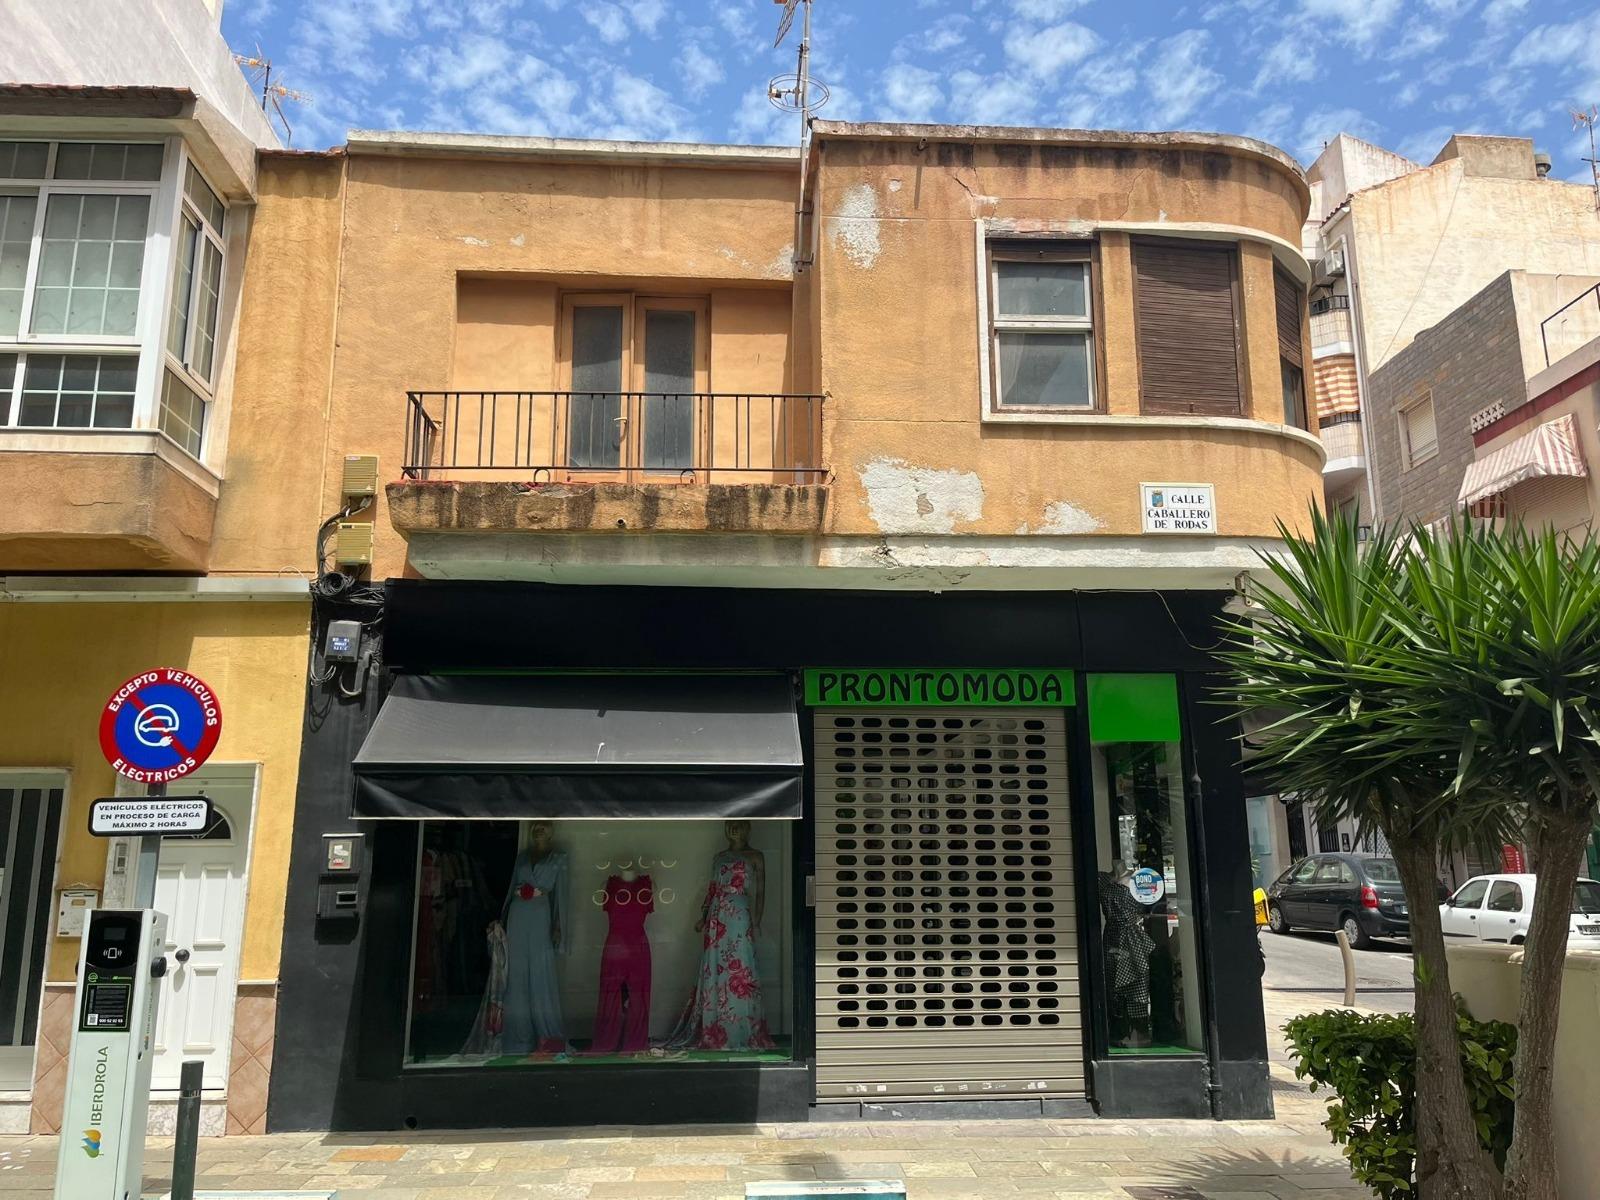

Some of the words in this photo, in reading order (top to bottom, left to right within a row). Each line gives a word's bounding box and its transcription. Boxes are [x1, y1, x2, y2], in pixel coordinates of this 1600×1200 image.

[1171, 494, 1205, 504] CALLE
[1147, 509, 1210, 519] CABALLERO
[1154, 520, 1168, 529] DE
[1174, 520, 1208, 529] RODAS
[108, 672, 158, 712] EXCEPTO
[166, 670, 218, 726] VEHICULOS
[818, 672, 1063, 703] PRONTOMODA
[112, 756, 196, 782] ELECTRICOS
[91, 1046, 108, 1126] IBERDROLA
